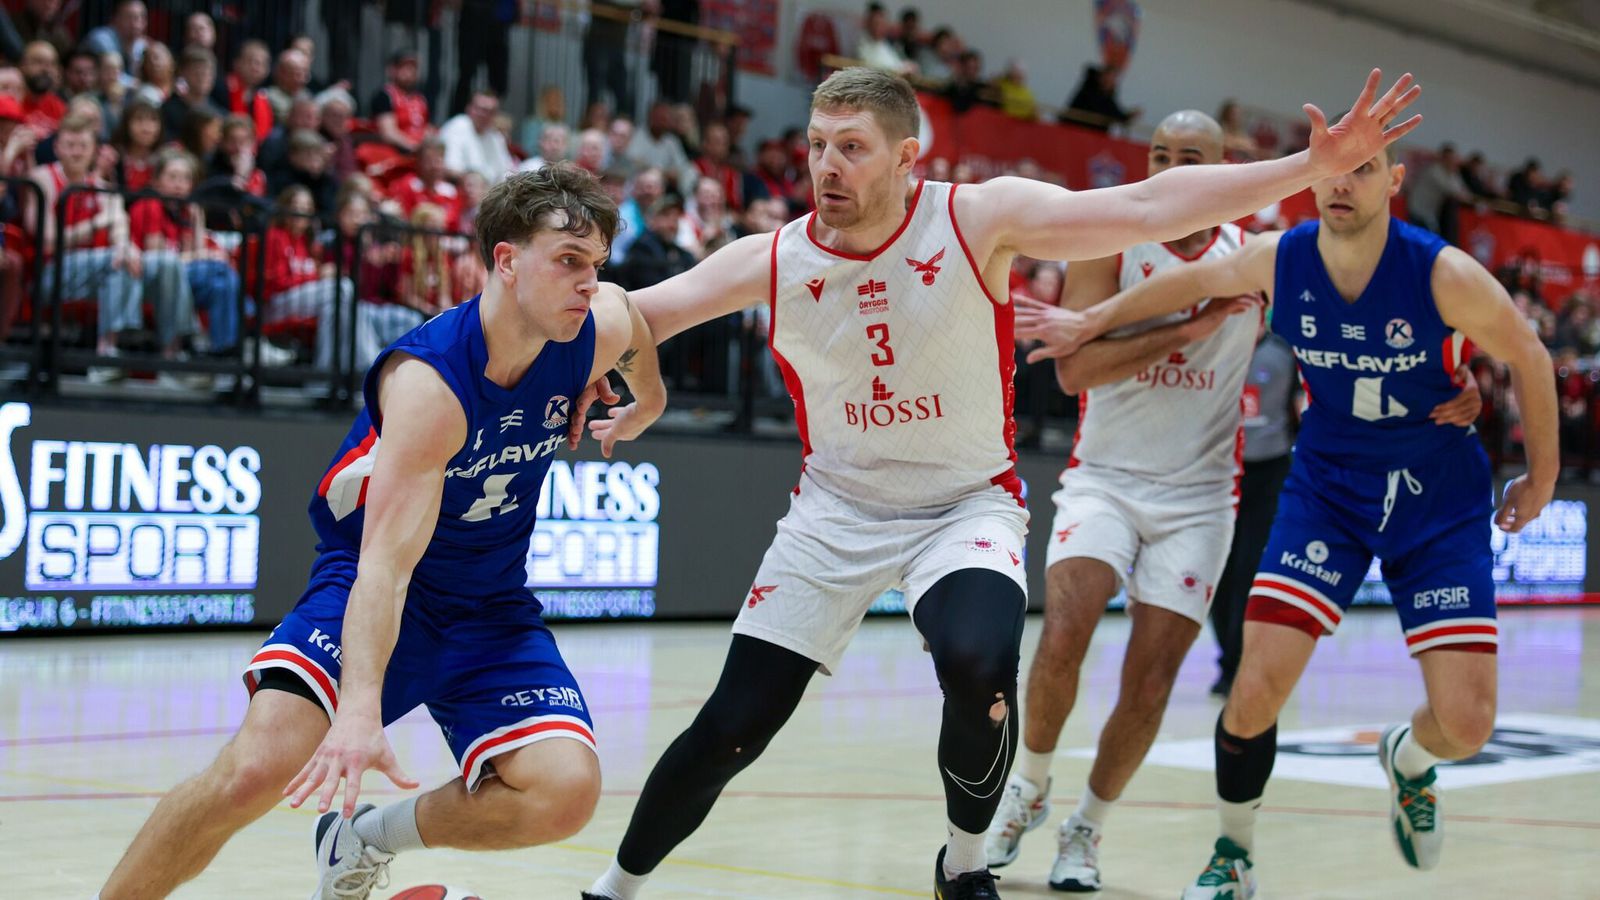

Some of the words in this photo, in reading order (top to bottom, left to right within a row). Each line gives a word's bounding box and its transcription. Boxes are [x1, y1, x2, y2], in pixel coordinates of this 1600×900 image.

[866, 323, 895, 366] 3
[1301, 314, 1317, 338] 5
[30, 440, 261, 514] FITNESS
[40, 522, 249, 582] SPORT
[1280, 551, 1342, 587] Kristall
[1413, 586, 1470, 609] GEYSIR
[307, 627, 342, 666] Kri
[501, 686, 581, 707] GEYSIR
